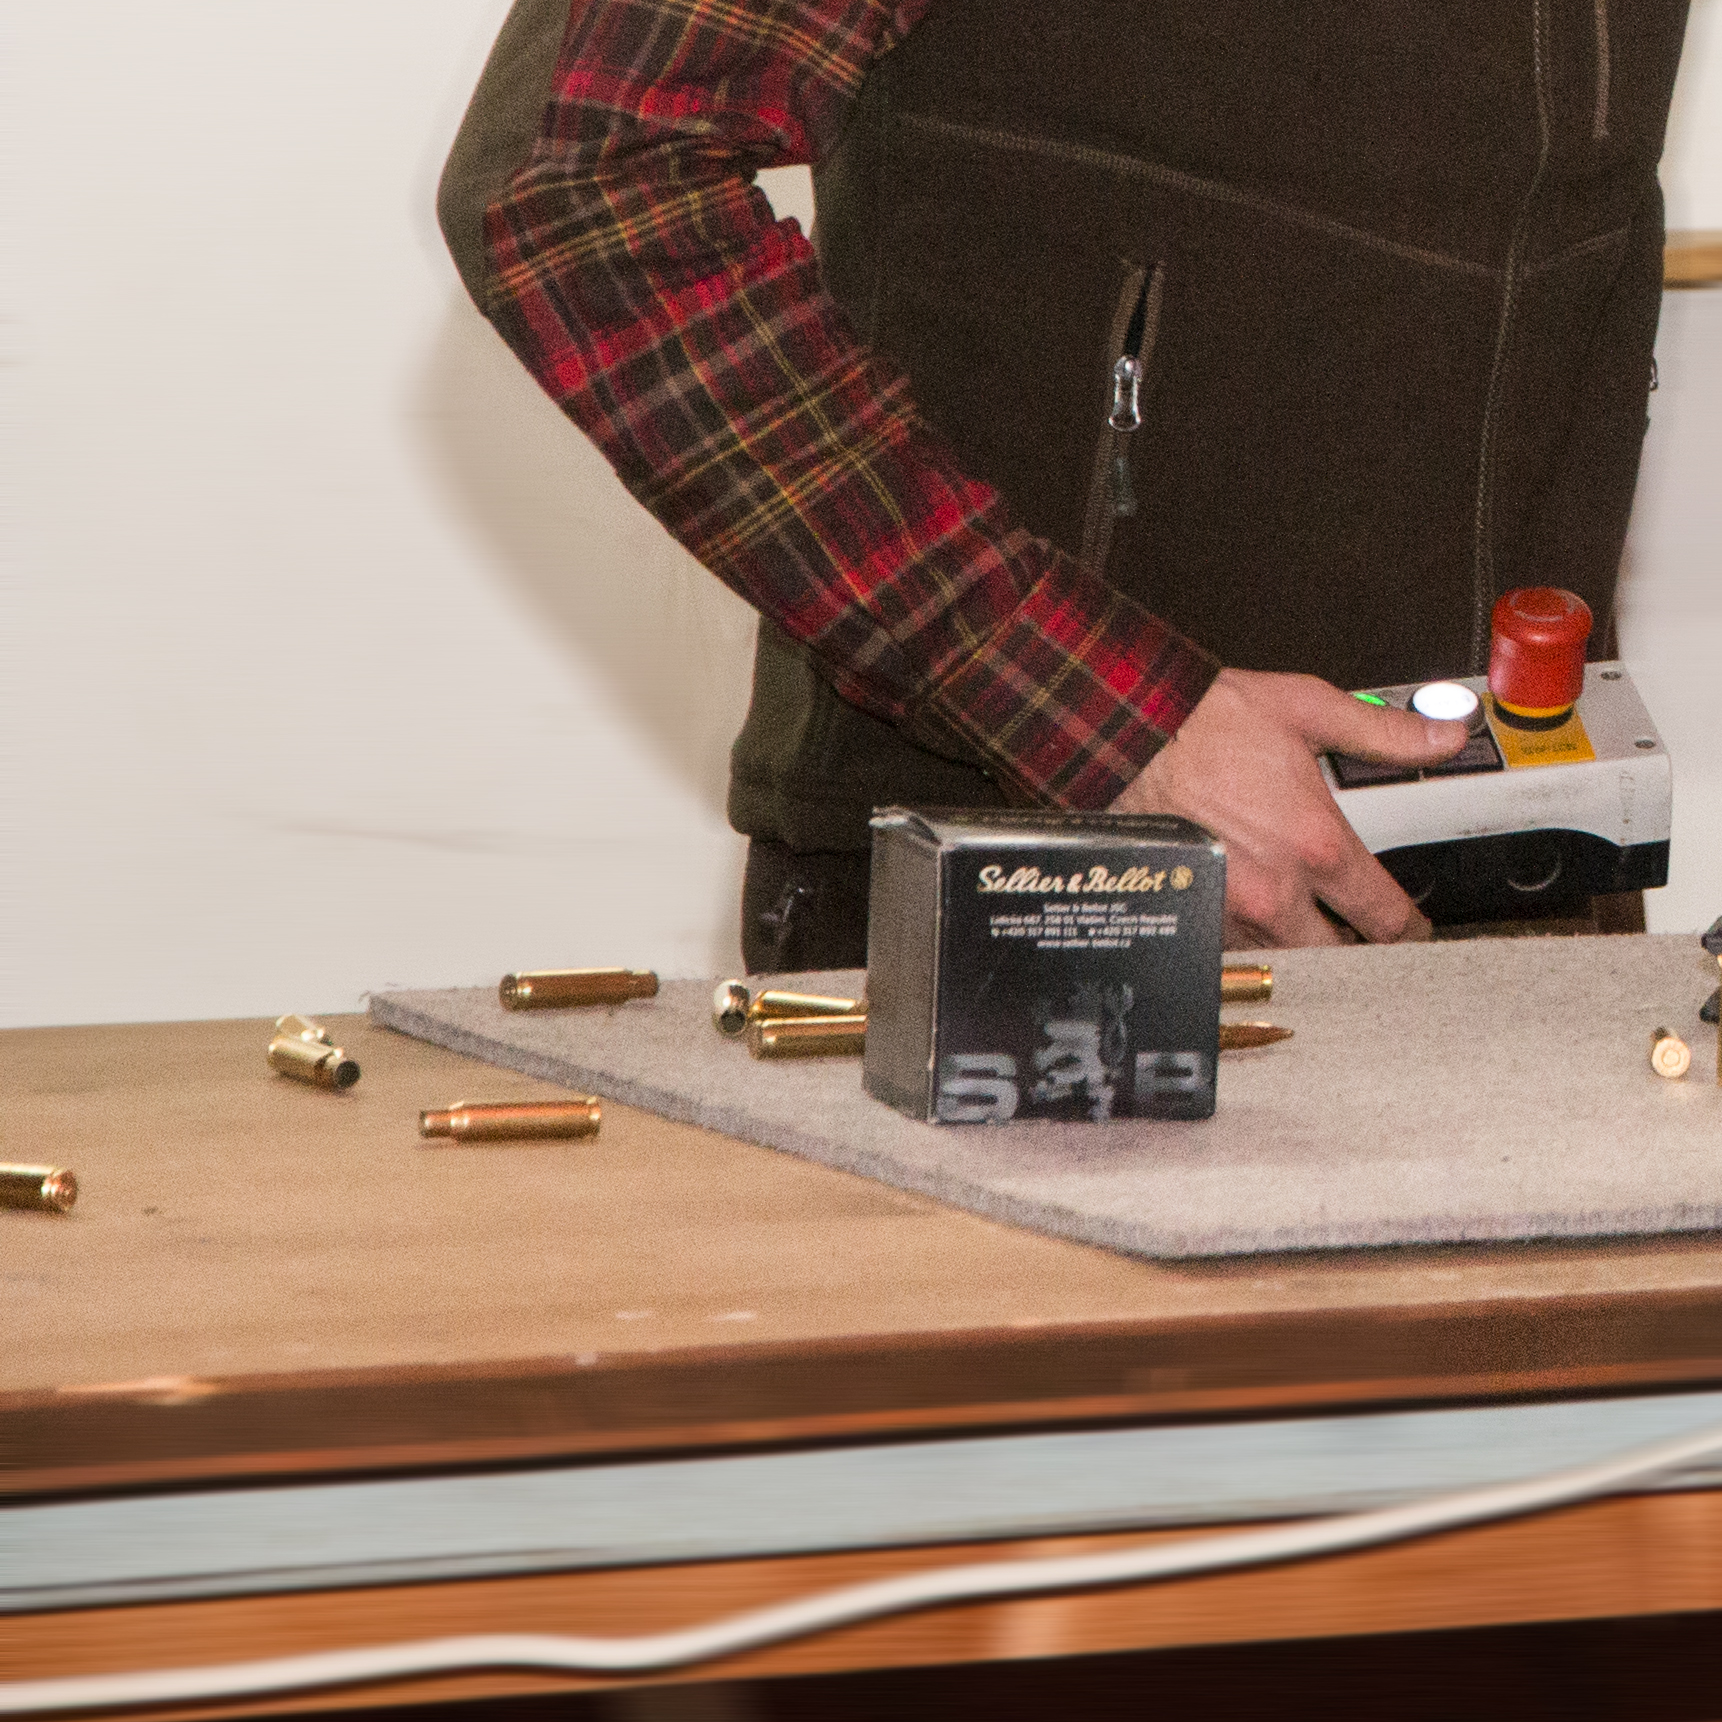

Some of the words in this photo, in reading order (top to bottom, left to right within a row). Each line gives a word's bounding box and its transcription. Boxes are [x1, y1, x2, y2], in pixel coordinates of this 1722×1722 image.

[976, 865, 1066, 894] Sellier
[1066, 873, 1084, 894] &
[1082, 864, 1168, 894] Bellot
